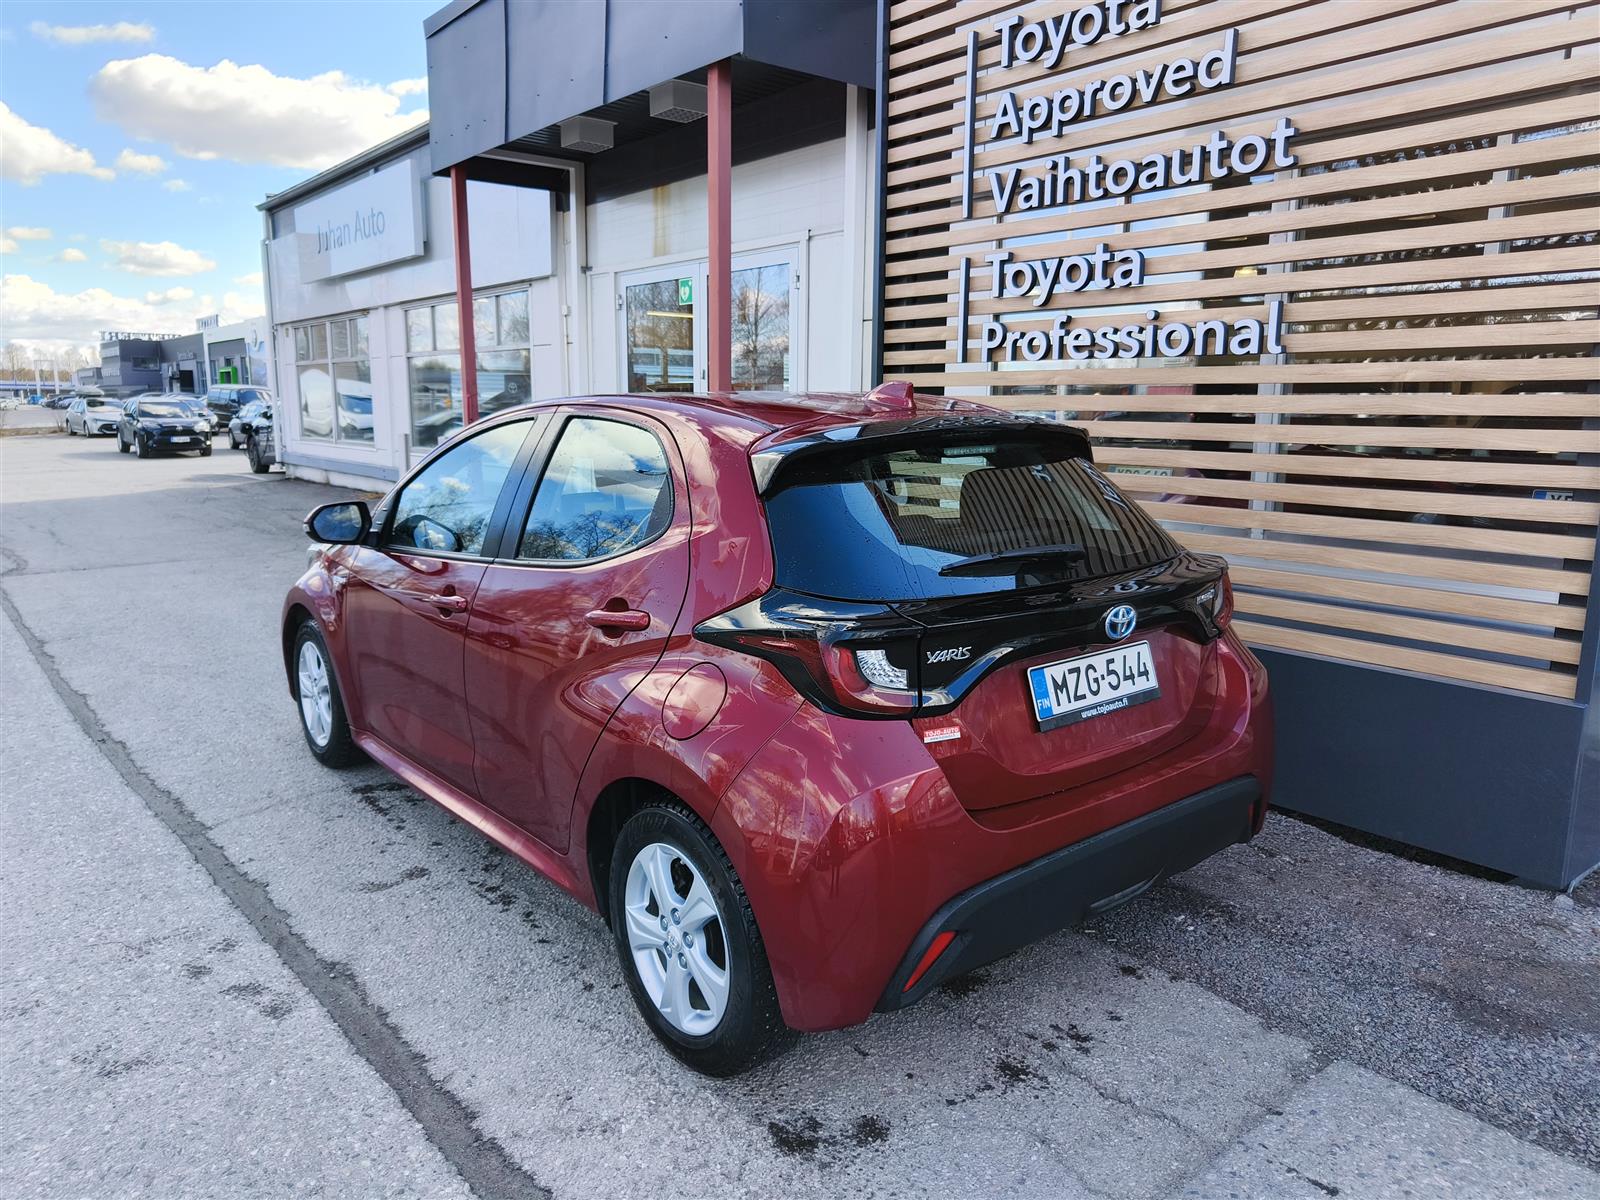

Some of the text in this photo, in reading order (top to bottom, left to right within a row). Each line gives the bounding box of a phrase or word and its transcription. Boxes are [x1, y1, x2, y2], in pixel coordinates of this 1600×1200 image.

[995, 0, 1161, 69] Toyota
[990, 27, 1239, 144] Approved
[989, 117, 1298, 214] Vaihtoautot
[317, 207, 386, 254] Juhan Auto
[985, 243, 1145, 305] Toyota
[981, 300, 1284, 362] Professional
[925, 727, 960, 737] TOJO-AUTO
[1037, 697, 1051, 711] FIN
[1081, 697, 1129, 719] www.tojoauto.fi
